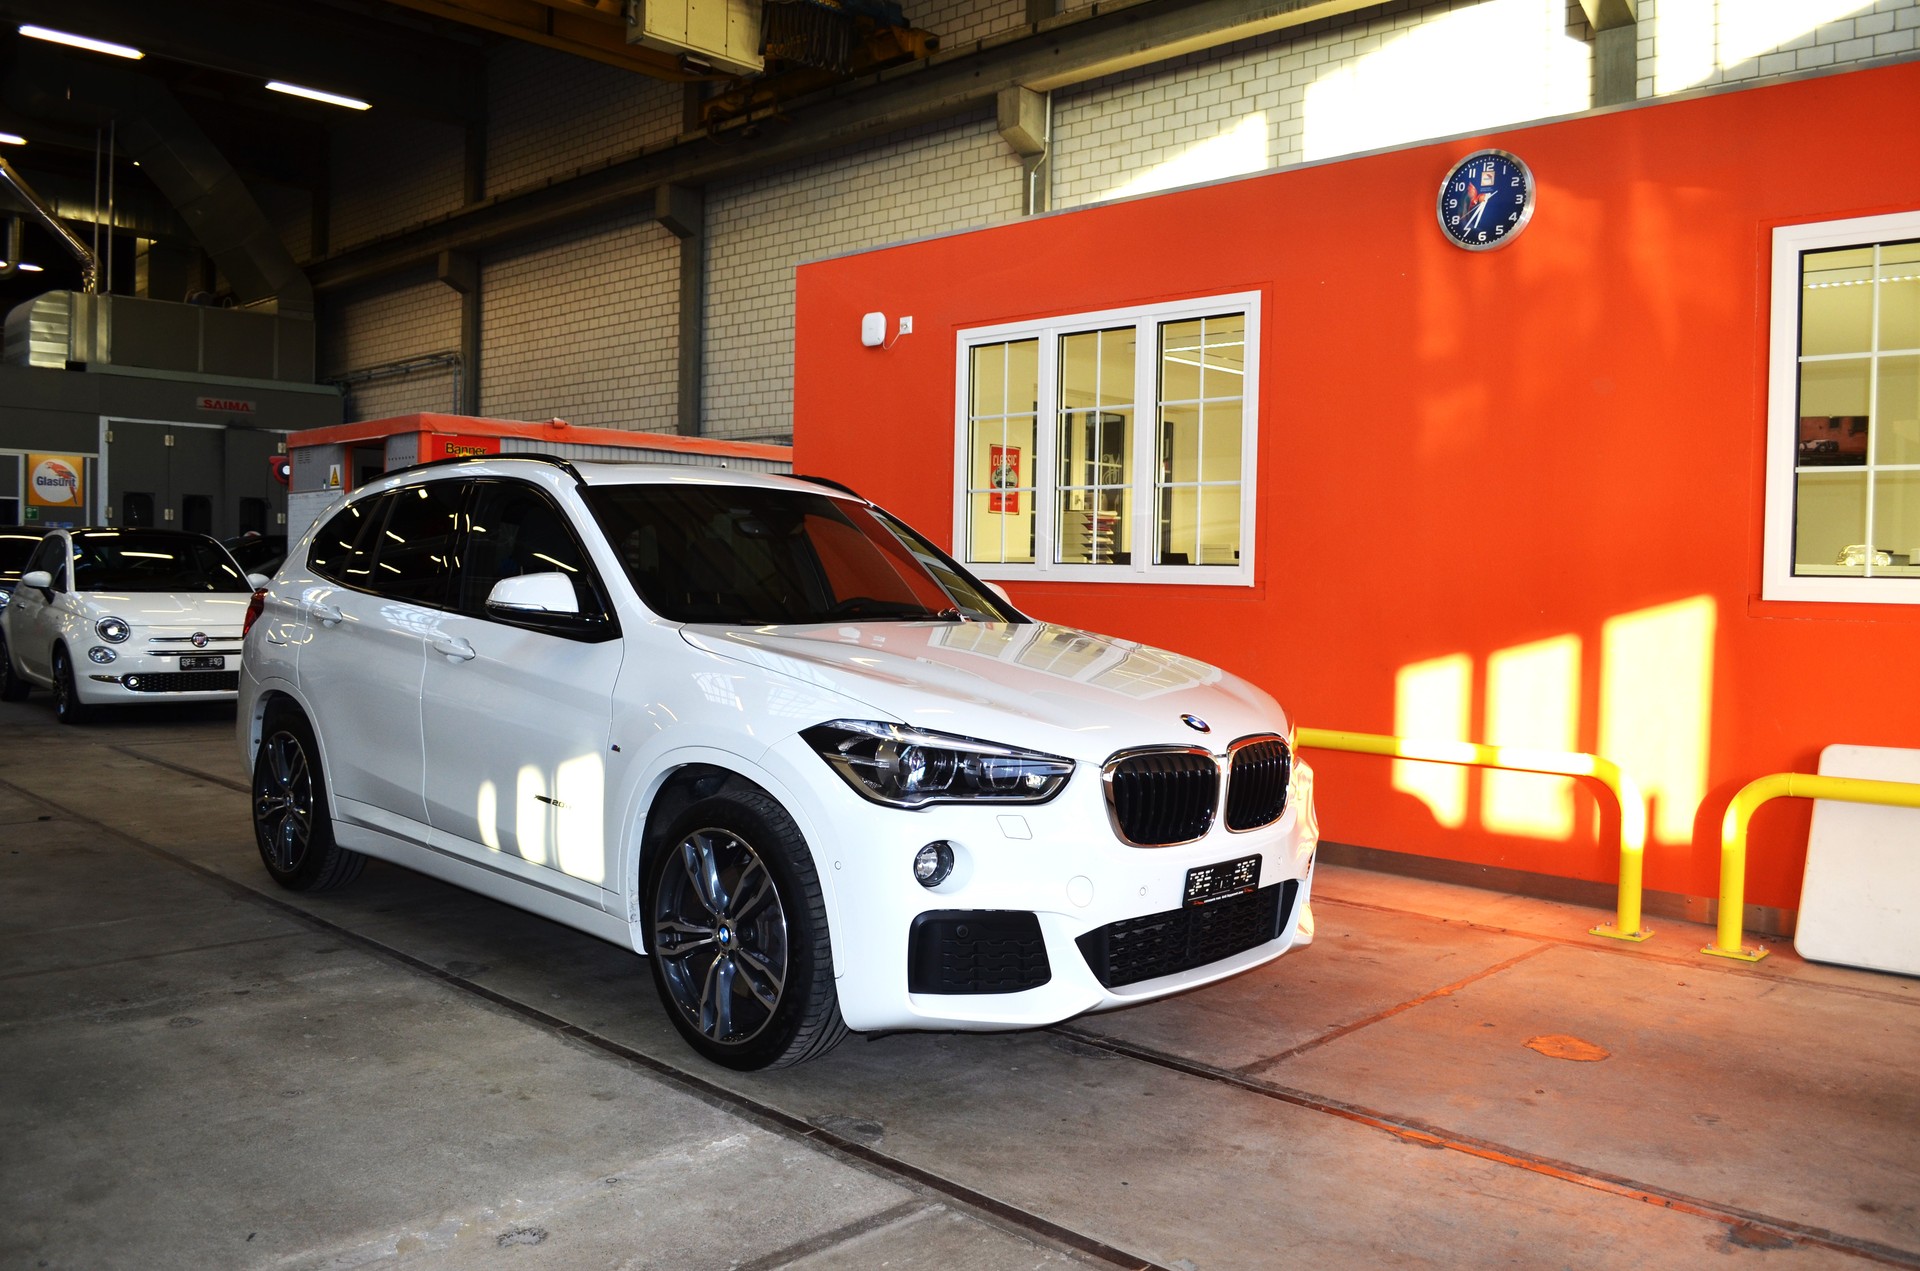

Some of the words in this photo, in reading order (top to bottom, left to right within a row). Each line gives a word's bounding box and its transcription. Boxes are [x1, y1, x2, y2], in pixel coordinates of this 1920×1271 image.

[1483, 162, 1495, 172] 12
[1503, 165, 1507, 175] 1
[1468, 168, 1476, 178] 11
[1455, 182, 1466, 192] 10
[1511, 177, 1520, 187] 2
[1449, 198, 1458, 209] 9
[1515, 194, 1523, 205] 3
[1451, 215, 1460, 225] 8
[1508, 212, 1517, 222] 4
[1463, 227, 1471, 238] 7
[1495, 225, 1504, 235] 5
[1478, 231, 1487, 241] 6
[203, 399, 250, 412] SAIMA
[445, 442, 487, 455] Banner
[992, 454, 1018, 466] CLASIC
[36, 476, 76, 487] Glasurit
